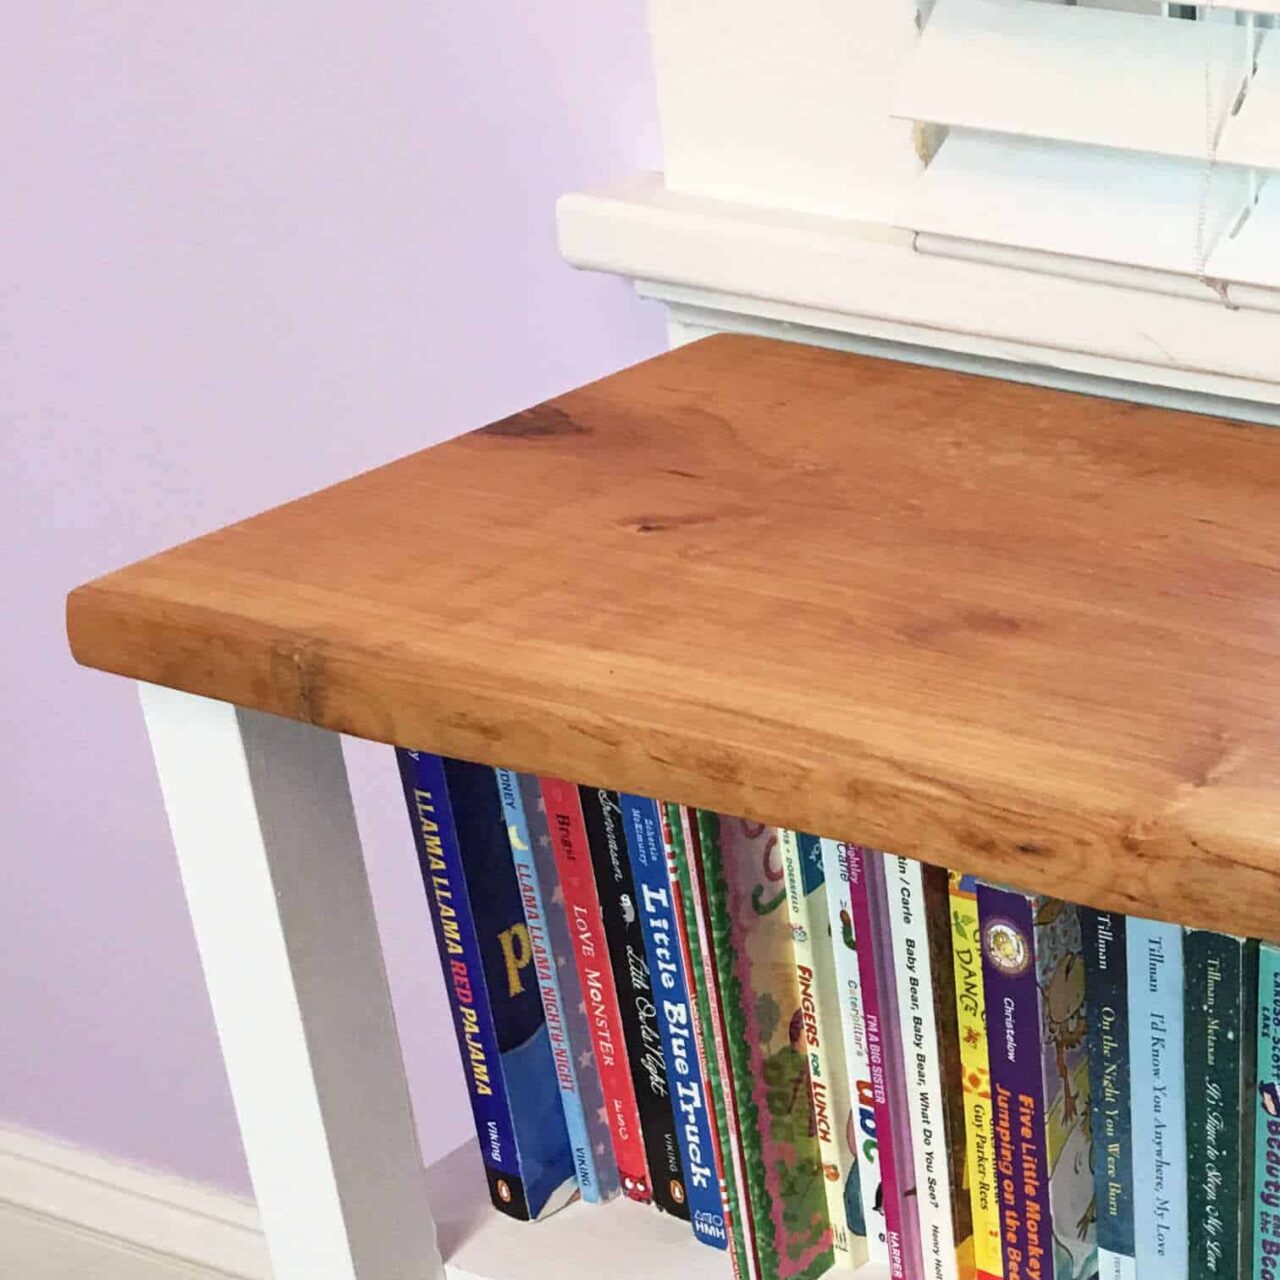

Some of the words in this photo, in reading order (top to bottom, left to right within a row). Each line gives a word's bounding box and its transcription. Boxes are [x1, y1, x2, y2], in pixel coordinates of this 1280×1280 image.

[414, 788, 446, 872] LLAMA
[432, 875, 464, 955] LLAMA
[516, 864, 539, 926] LLAMA
[531, 925, 554, 984] LLAMA
[900, 884, 911, 924] Carle
[905, 938, 917, 974] Baby
[1097, 914, 1114, 970] Tillman
[450, 959, 473, 1004] RED
[1148, 937, 1164, 993] Tillman
[1207, 957, 1222, 1005] Tillman
[641, 883, 676, 989] Little
[662, 1000, 690, 1076] Blue
[677, 1080, 711, 1188] Truck
[912, 1015, 923, 1050] Baby
[1101, 1007, 1116, 1036] On
[1260, 1006, 1271, 1040] LAKE
[459, 1003, 493, 1096] PAJAMA
[797, 964, 818, 1048] FINGERS
[811, 1082, 832, 1144] LUNCH
[869, 1041, 881, 1060] BIG
[1103, 1038, 1119, 1058] the
[1151, 1036, 1166, 1079] Know
[872, 1063, 886, 1104] SISTER
[1103, 1062, 1120, 1102] Night
[1152, 1085, 1168, 1113] You
[920, 1091, 931, 1129] What
[997, 1083, 1014, 1176] Jumping
[1018, 1094, 1035, 1134] Five
[1104, 1108, 1120, 1136] You
[924, 1131, 932, 1146] Do
[925, 1150, 935, 1173] You
[1020, 1137, 1038, 1197] Little
[1107, 1142, 1121, 1177] Were
[1003, 1178, 1014, 1206] on
[1154, 1196, 1171, 1222] My
[1005, 1210, 1018, 1245] the
[1156, 1226, 1171, 1257] Love
[888, 1231, 902, 1279] HARPER
